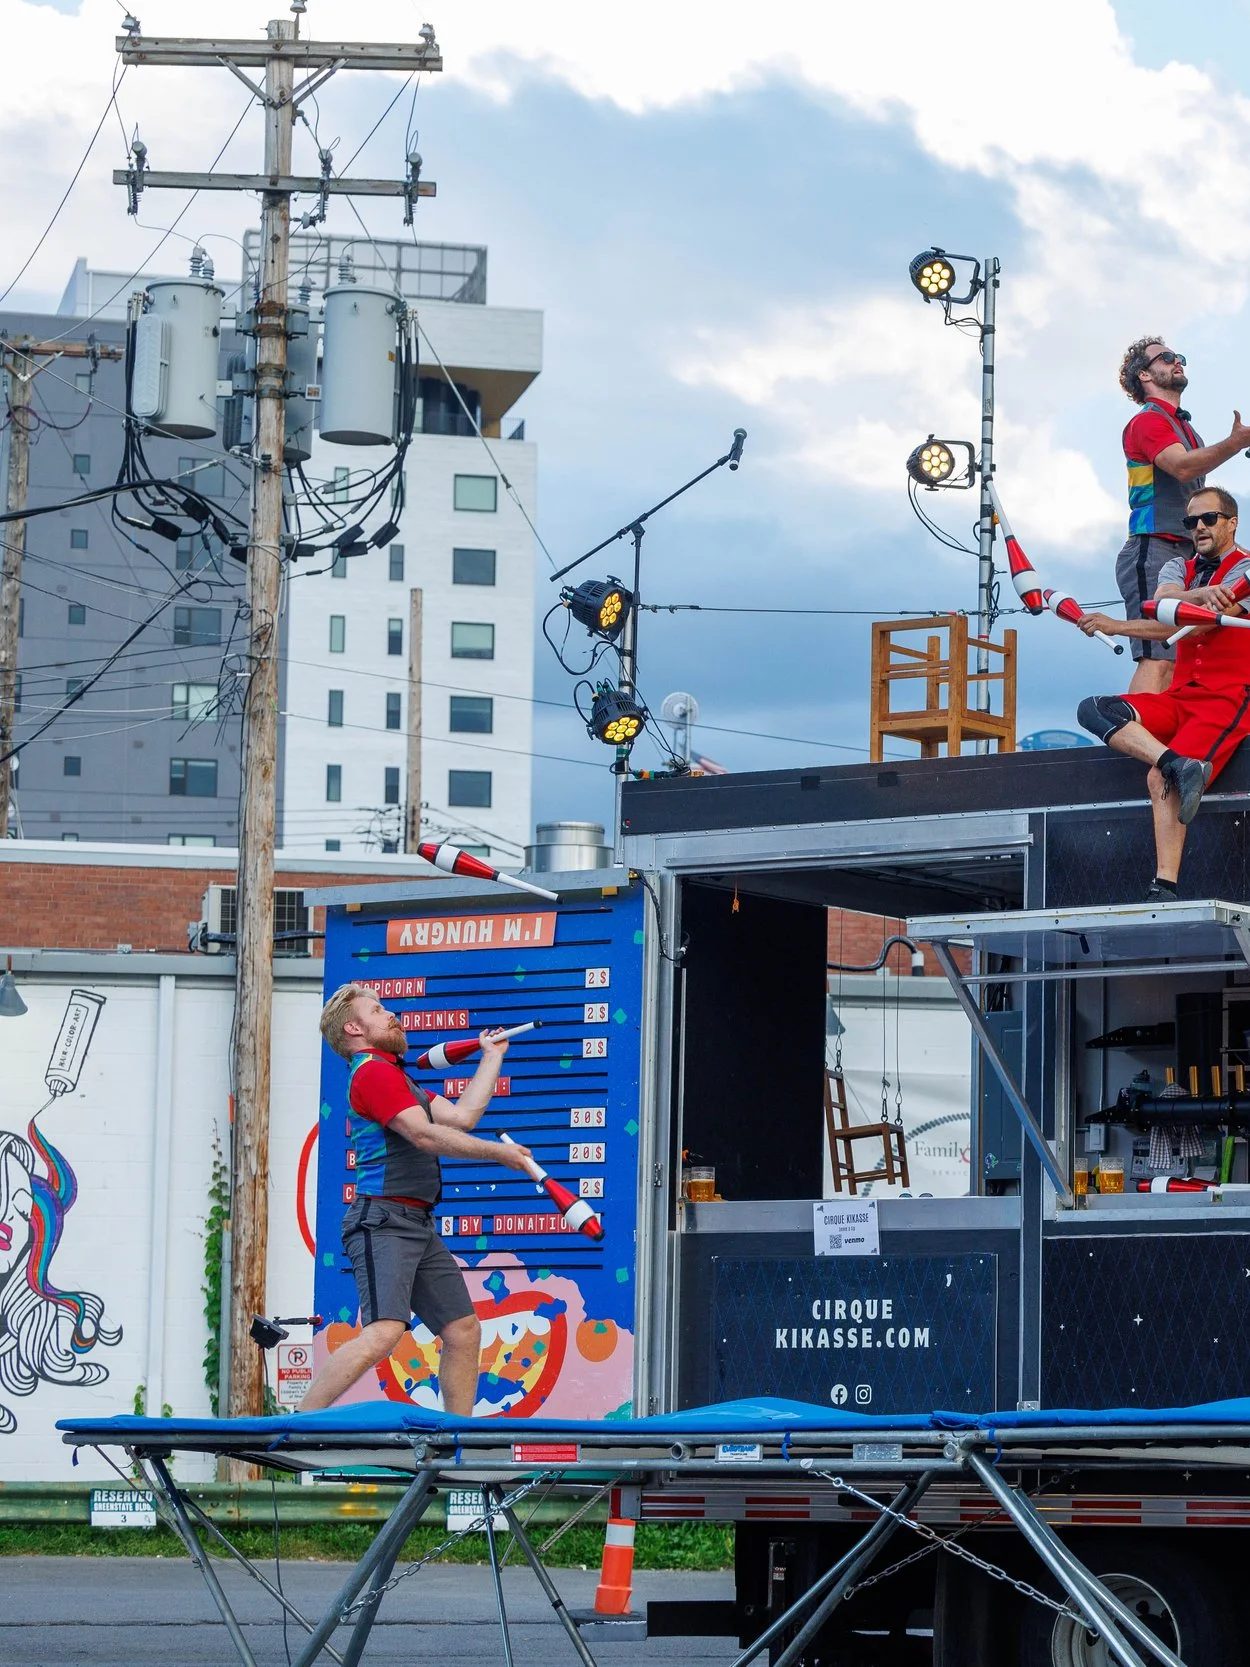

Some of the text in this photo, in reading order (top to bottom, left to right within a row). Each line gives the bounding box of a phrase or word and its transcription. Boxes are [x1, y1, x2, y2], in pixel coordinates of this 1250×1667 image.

[400, 917, 542, 947] I'M HUNGRY
[404, 1012, 466, 1028] DRINKS
[574, 1110, 602, 1125] 30$
[572, 1146, 602, 1160] 20$
[462, 1219, 478, 1232] BY
[496, 1217, 575, 1230] DONATIO
[824, 1213, 868, 1225] CIRQUE KIKASSE
[812, 1299, 893, 1323] CIRQUE
[776, 1328, 930, 1348] KIKASSE.COM
[94, 1490, 152, 1502] RESERVED
[121, 1515, 126, 1523] 3
